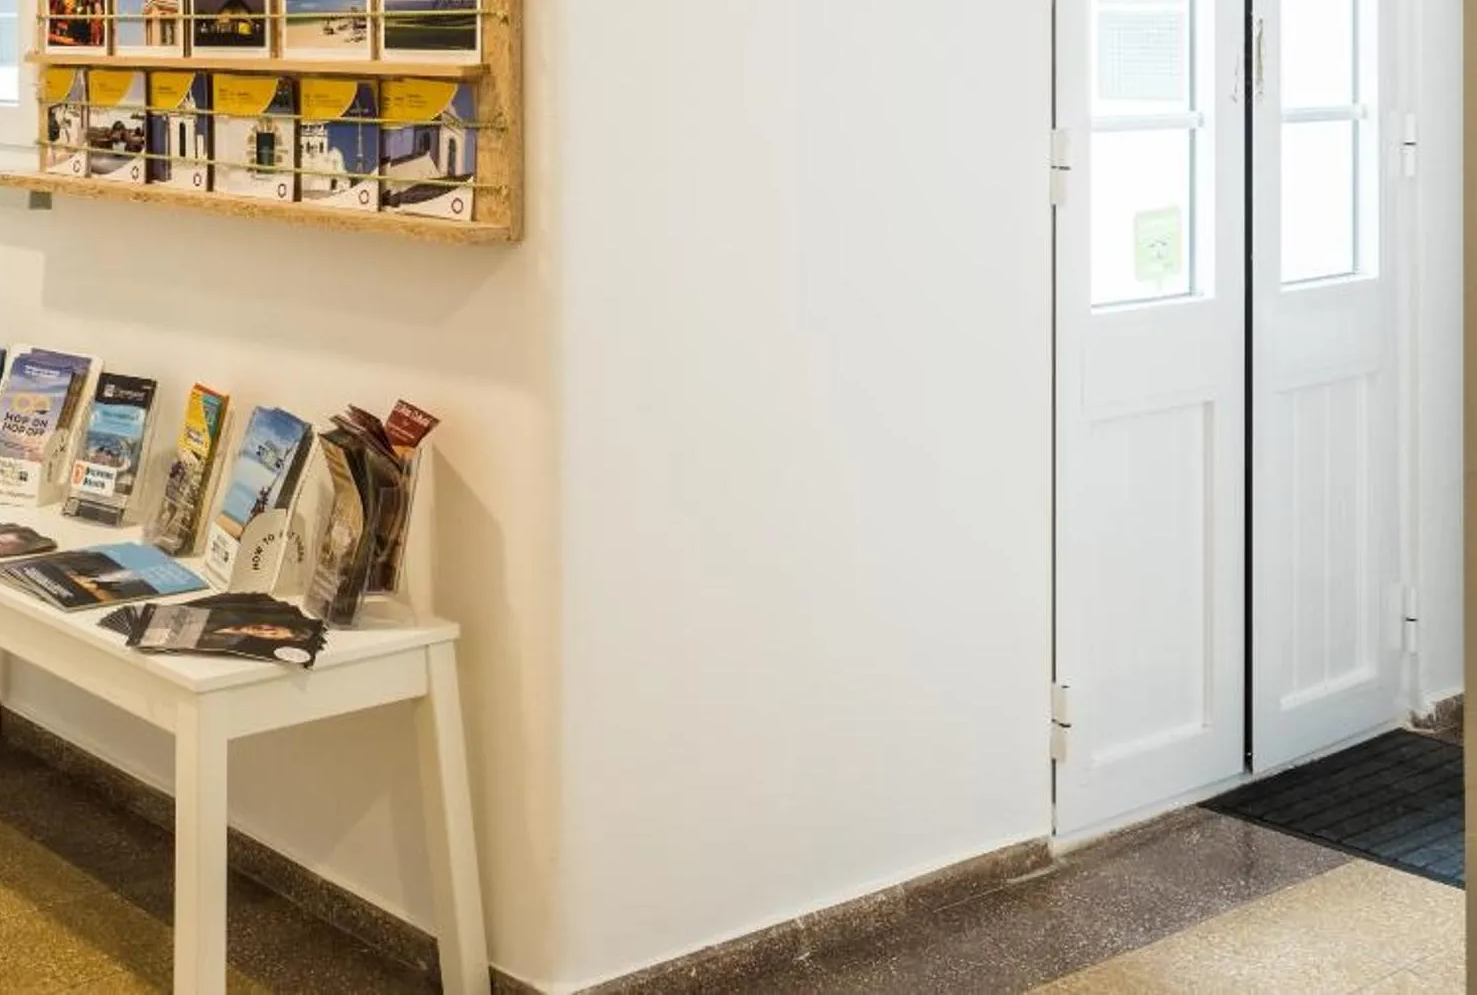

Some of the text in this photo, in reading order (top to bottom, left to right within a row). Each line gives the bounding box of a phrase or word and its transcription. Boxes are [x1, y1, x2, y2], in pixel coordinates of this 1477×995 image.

[4, 411, 49, 428] HOP ON
[2, 422, 46, 437] HOP OFF
[251, 533, 275, 570] HOW TO
